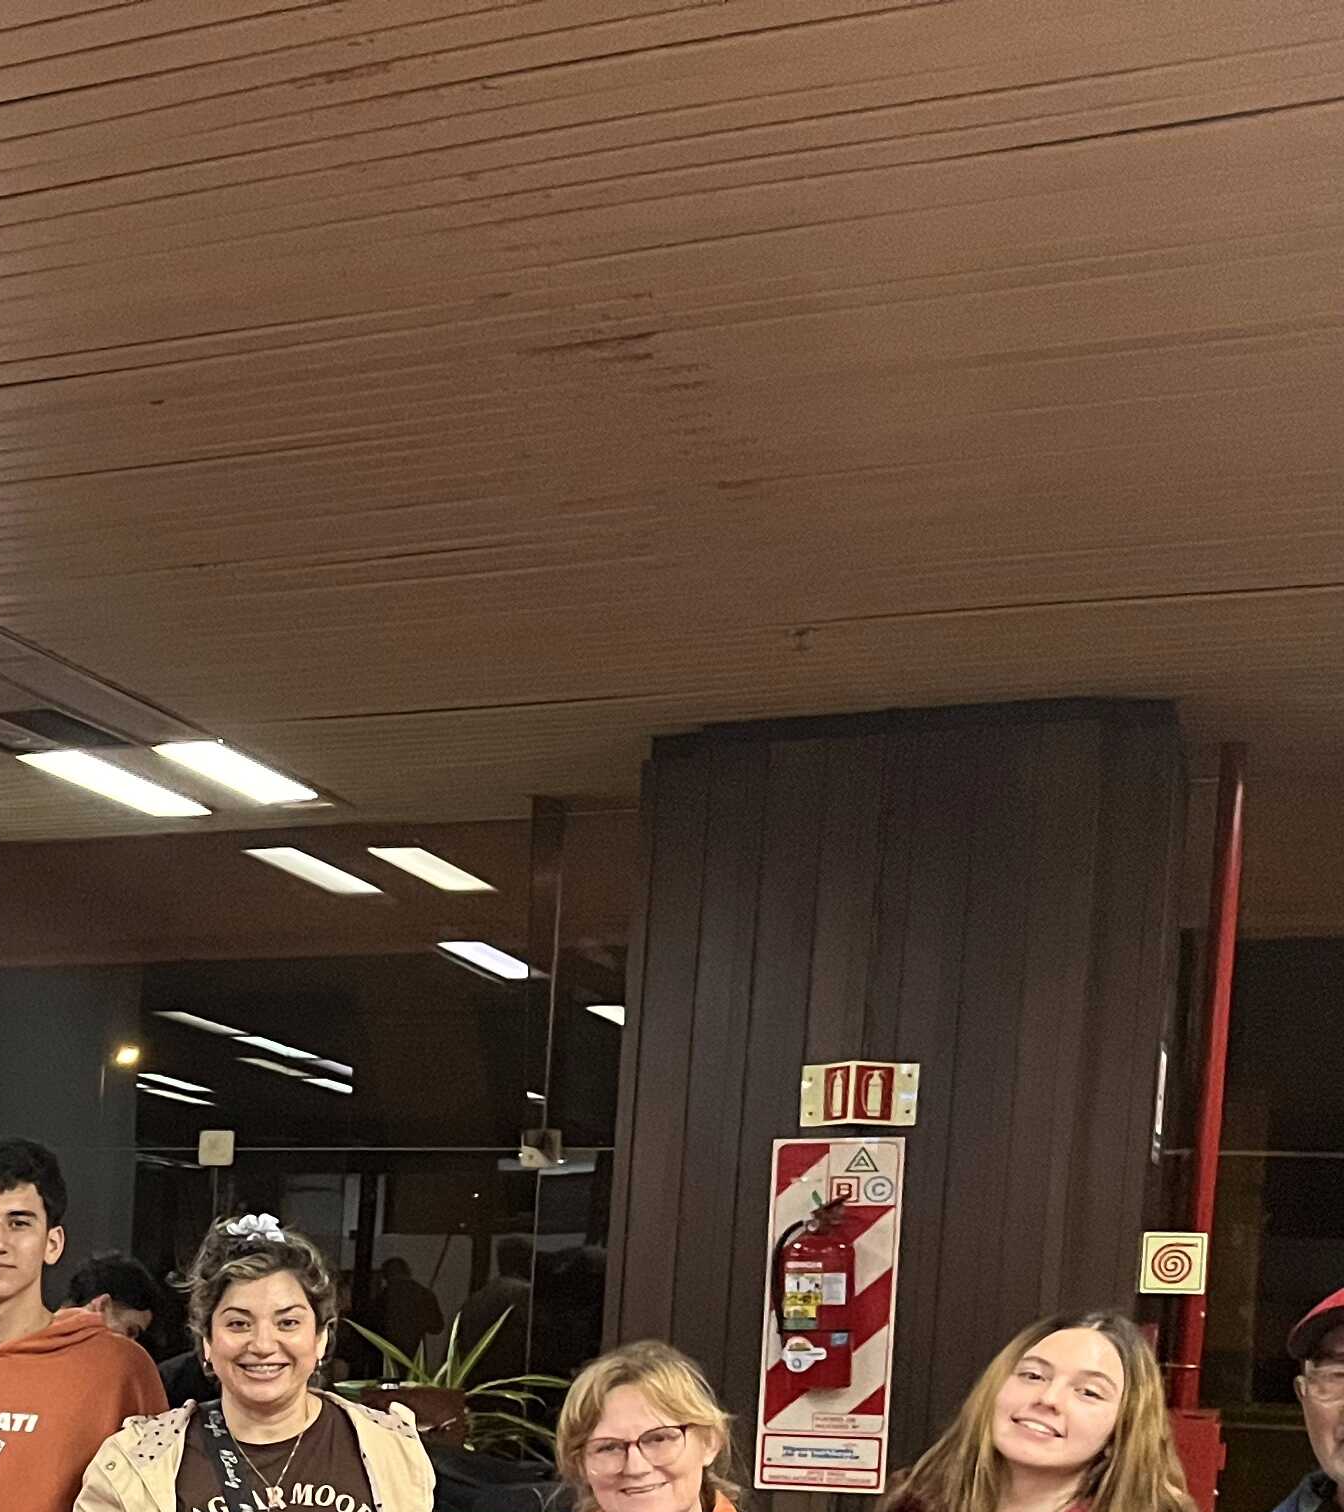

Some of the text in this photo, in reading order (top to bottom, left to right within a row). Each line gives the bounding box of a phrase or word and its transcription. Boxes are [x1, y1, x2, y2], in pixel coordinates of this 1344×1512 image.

[854, 1156, 870, 1168] A
[836, 1183, 886, 1198] B C
